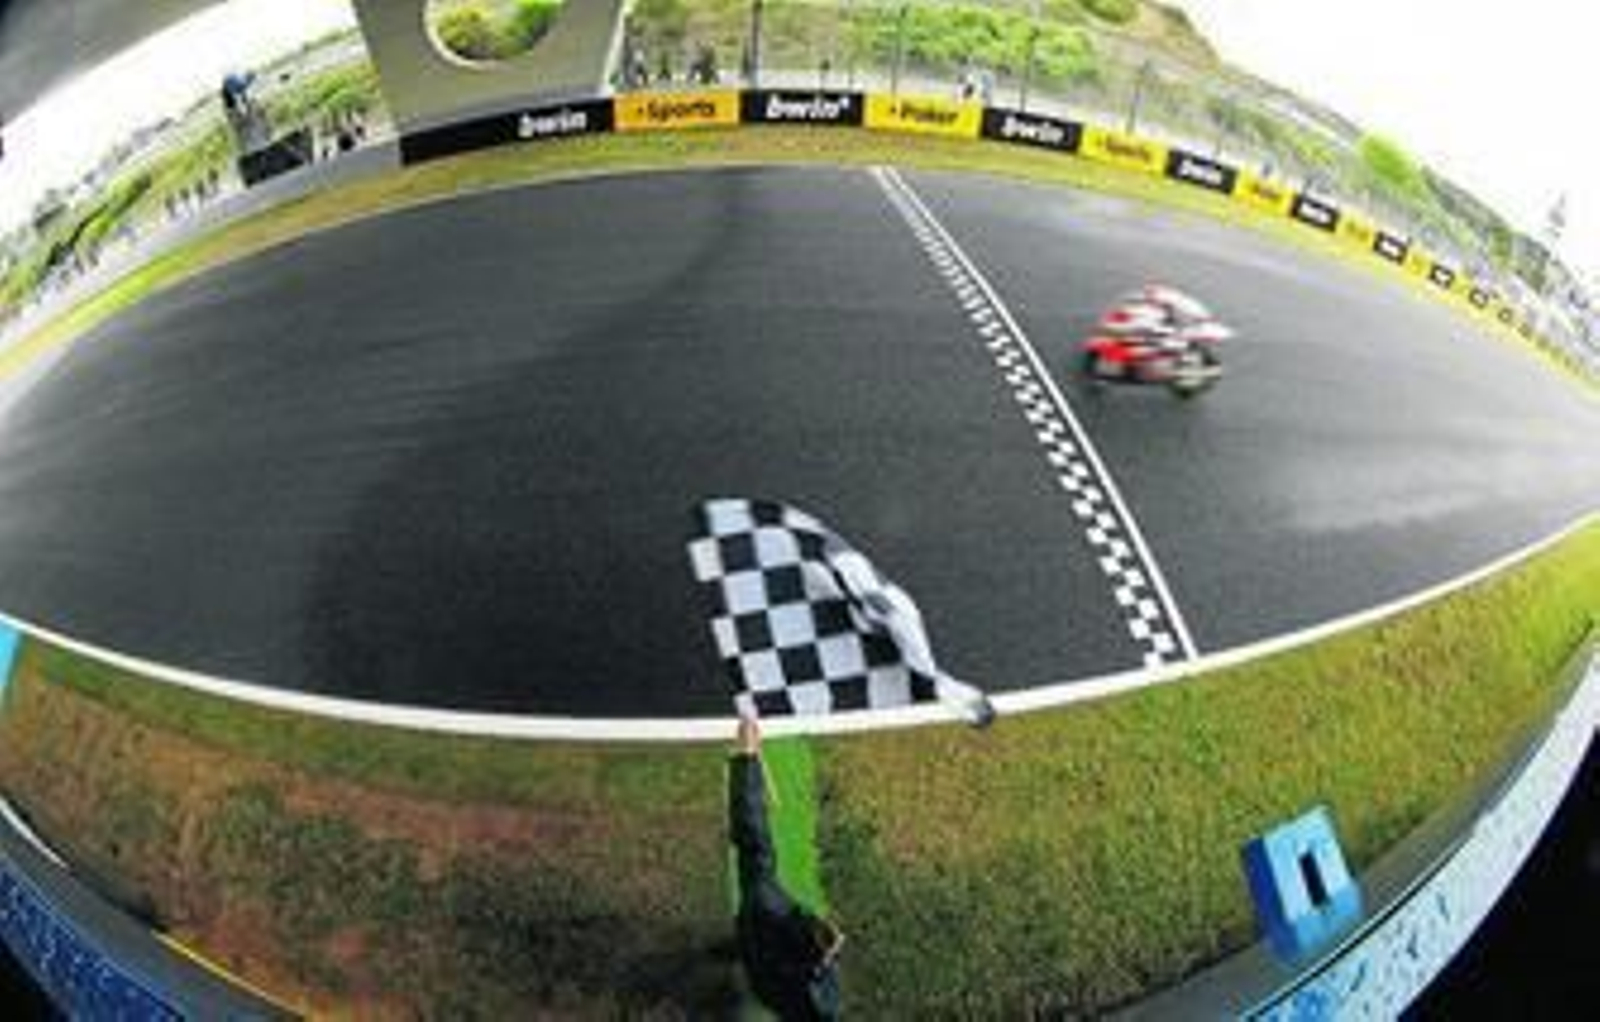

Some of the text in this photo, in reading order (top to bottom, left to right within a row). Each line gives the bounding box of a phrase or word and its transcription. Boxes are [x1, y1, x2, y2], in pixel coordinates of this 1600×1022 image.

[766, 95, 841, 118] bwin
[518, 110, 587, 137] bwin
[1000, 116, 1064, 145] bwin
